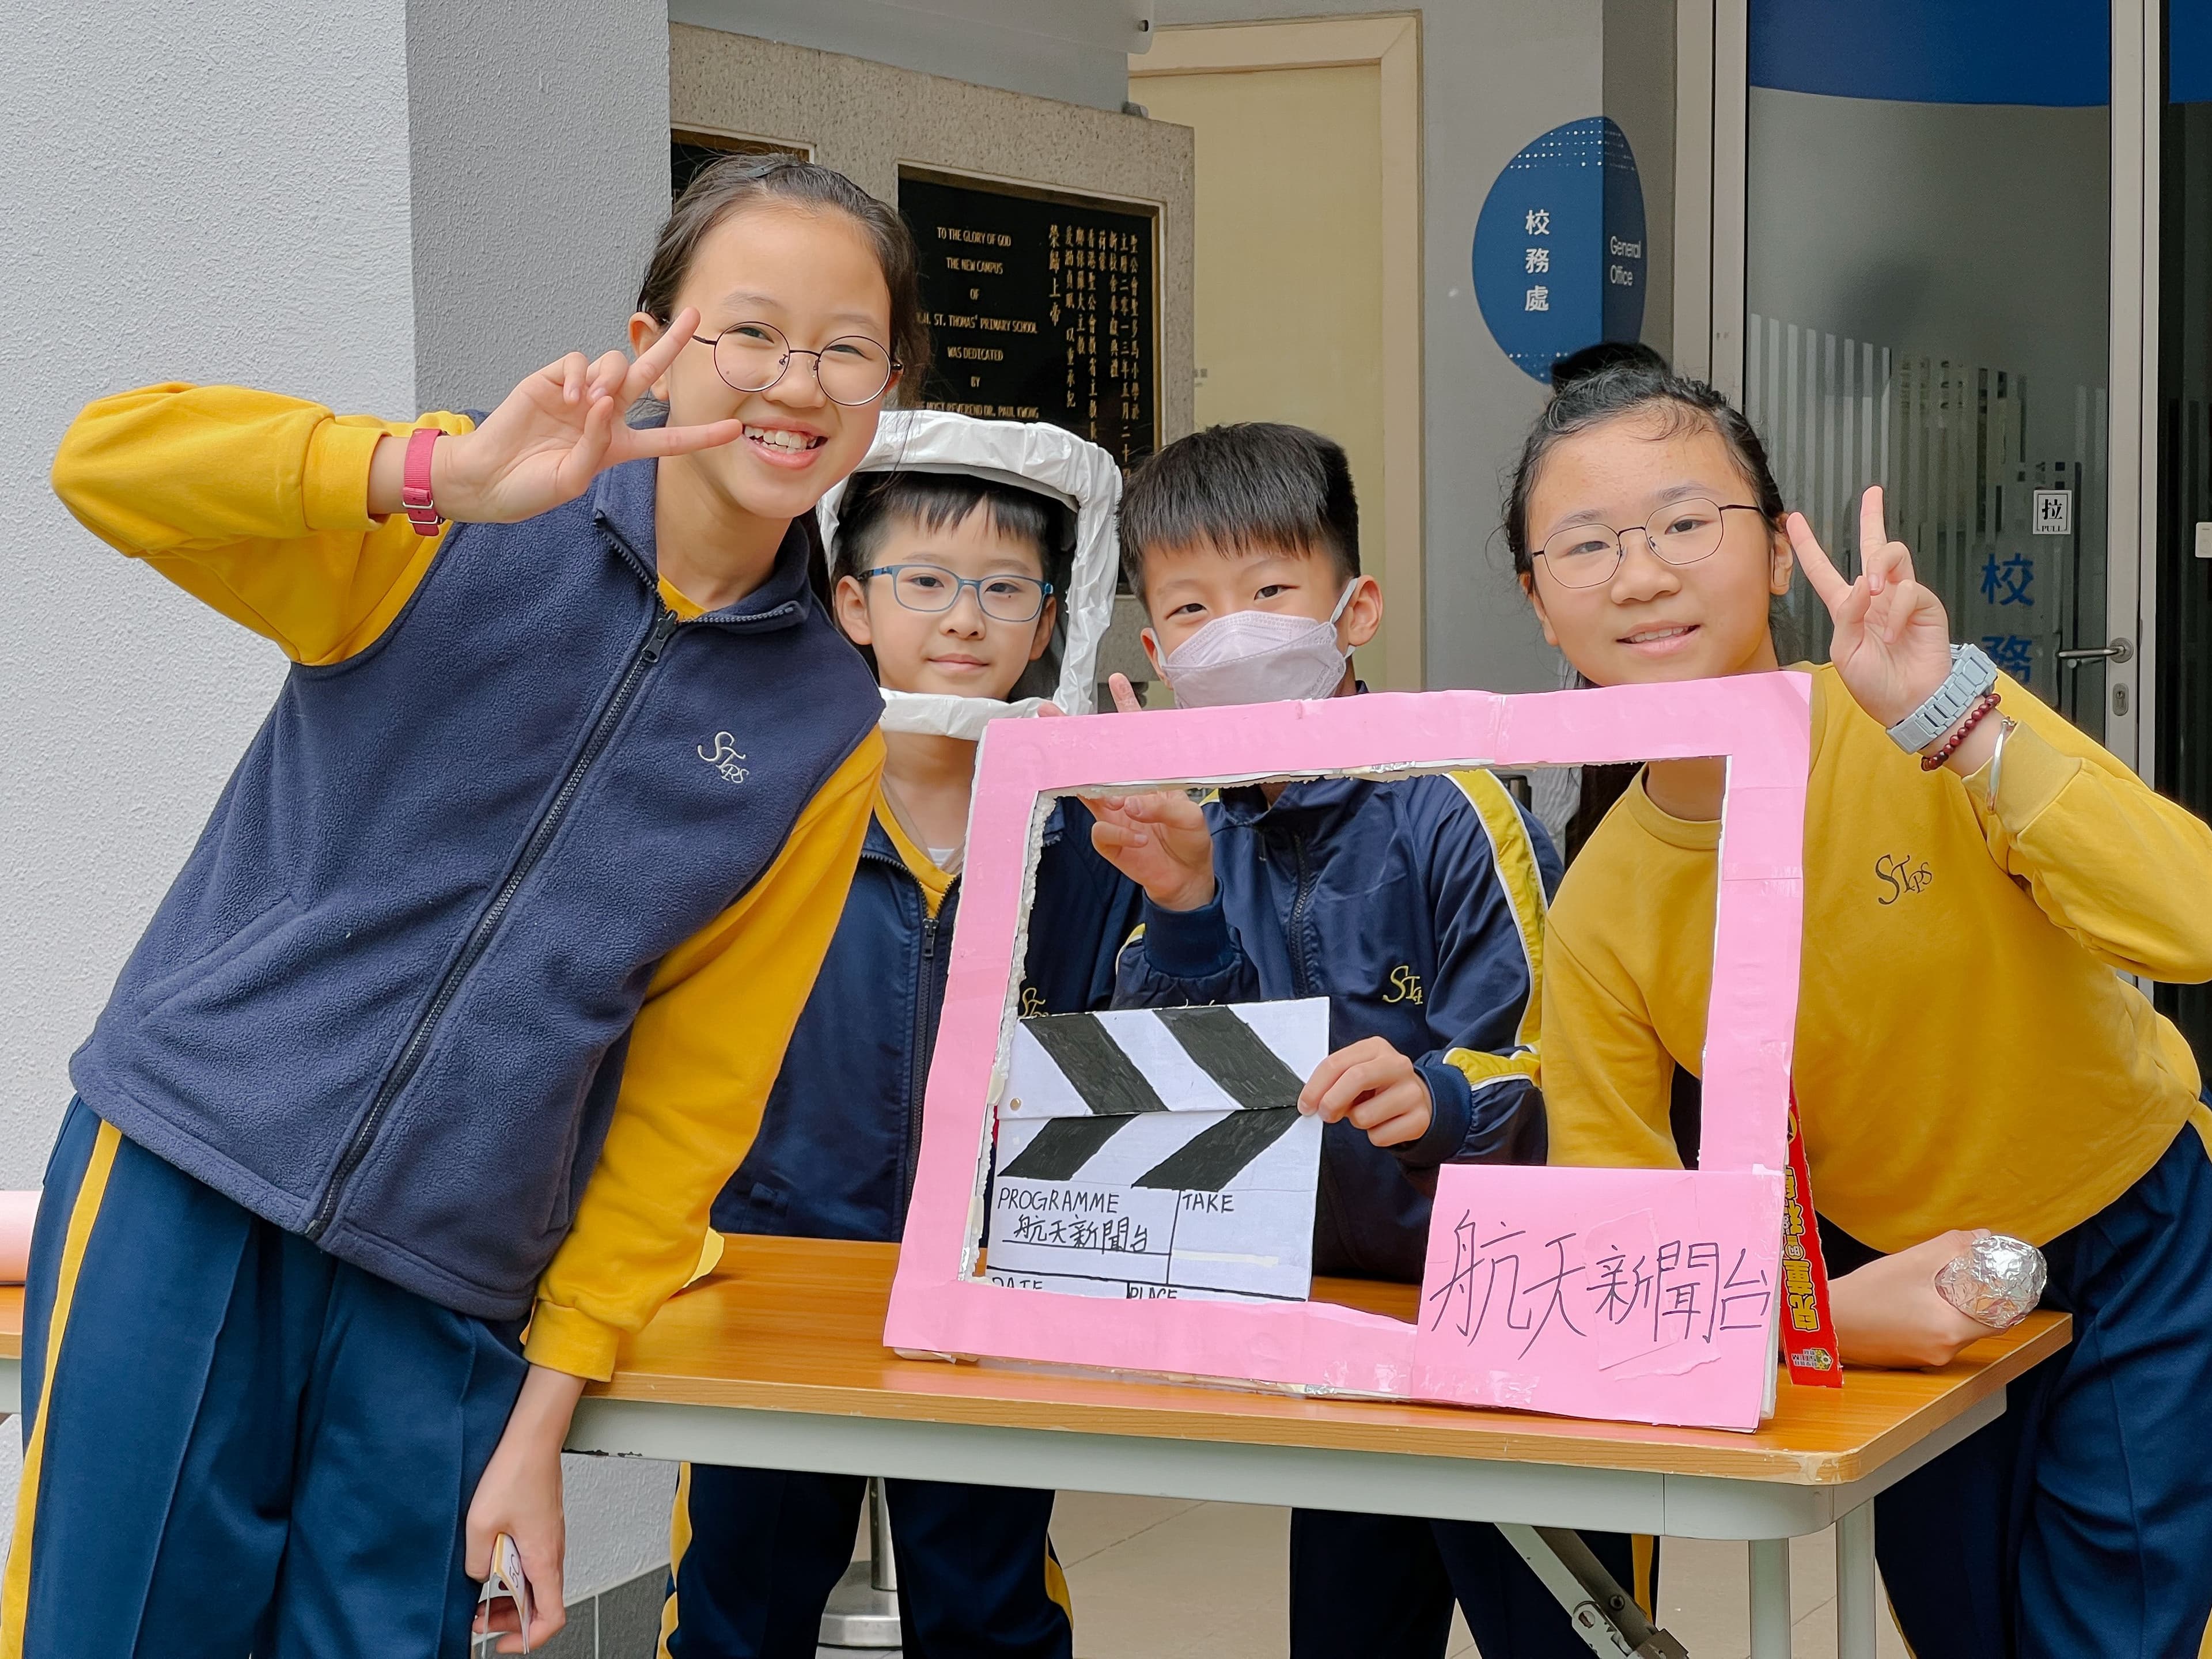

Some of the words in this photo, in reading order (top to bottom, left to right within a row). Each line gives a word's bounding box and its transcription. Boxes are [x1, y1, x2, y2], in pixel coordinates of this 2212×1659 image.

[937, 227, 947, 239] TO
[948, 228, 962, 241] THE
[963, 230, 986, 244] GLORY
[987, 233, 997, 245] OF
[998, 234, 1011, 247] GOD
[1611, 236, 1641, 258] General
[946, 257, 960, 270] THE
[961, 259, 975, 271] NEW
[977, 260, 1003, 275] CAMPUS
[1525, 209, 1550, 312] 校務處
[1048, 224, 1061, 327] 榮歸上帝
[1611, 264, 1633, 286] Office
[970, 289, 979, 300] OF
[934, 313, 946, 327] ST.
[980, 317, 1010, 331] PRIMARY
[1012, 320, 1038, 334] SCHOOL
[948, 346, 962, 359] WAS
[963, 347, 1003, 361] DEDICATED
[971, 376, 980, 388] BY
[984, 405, 996, 416] DR.
[998, 406, 1016, 418] PAUL
[1017, 407, 1039, 419] KWONG
[2041, 499, 2063, 520] 拉
[997, 1187, 1120, 1214] PROGRAMME
[1182, 1192, 1234, 1213] TAKE
[1013, 1213, 1148, 1255] 航天新聞台
[1429, 1209, 1771, 1360] 航天新聞台
